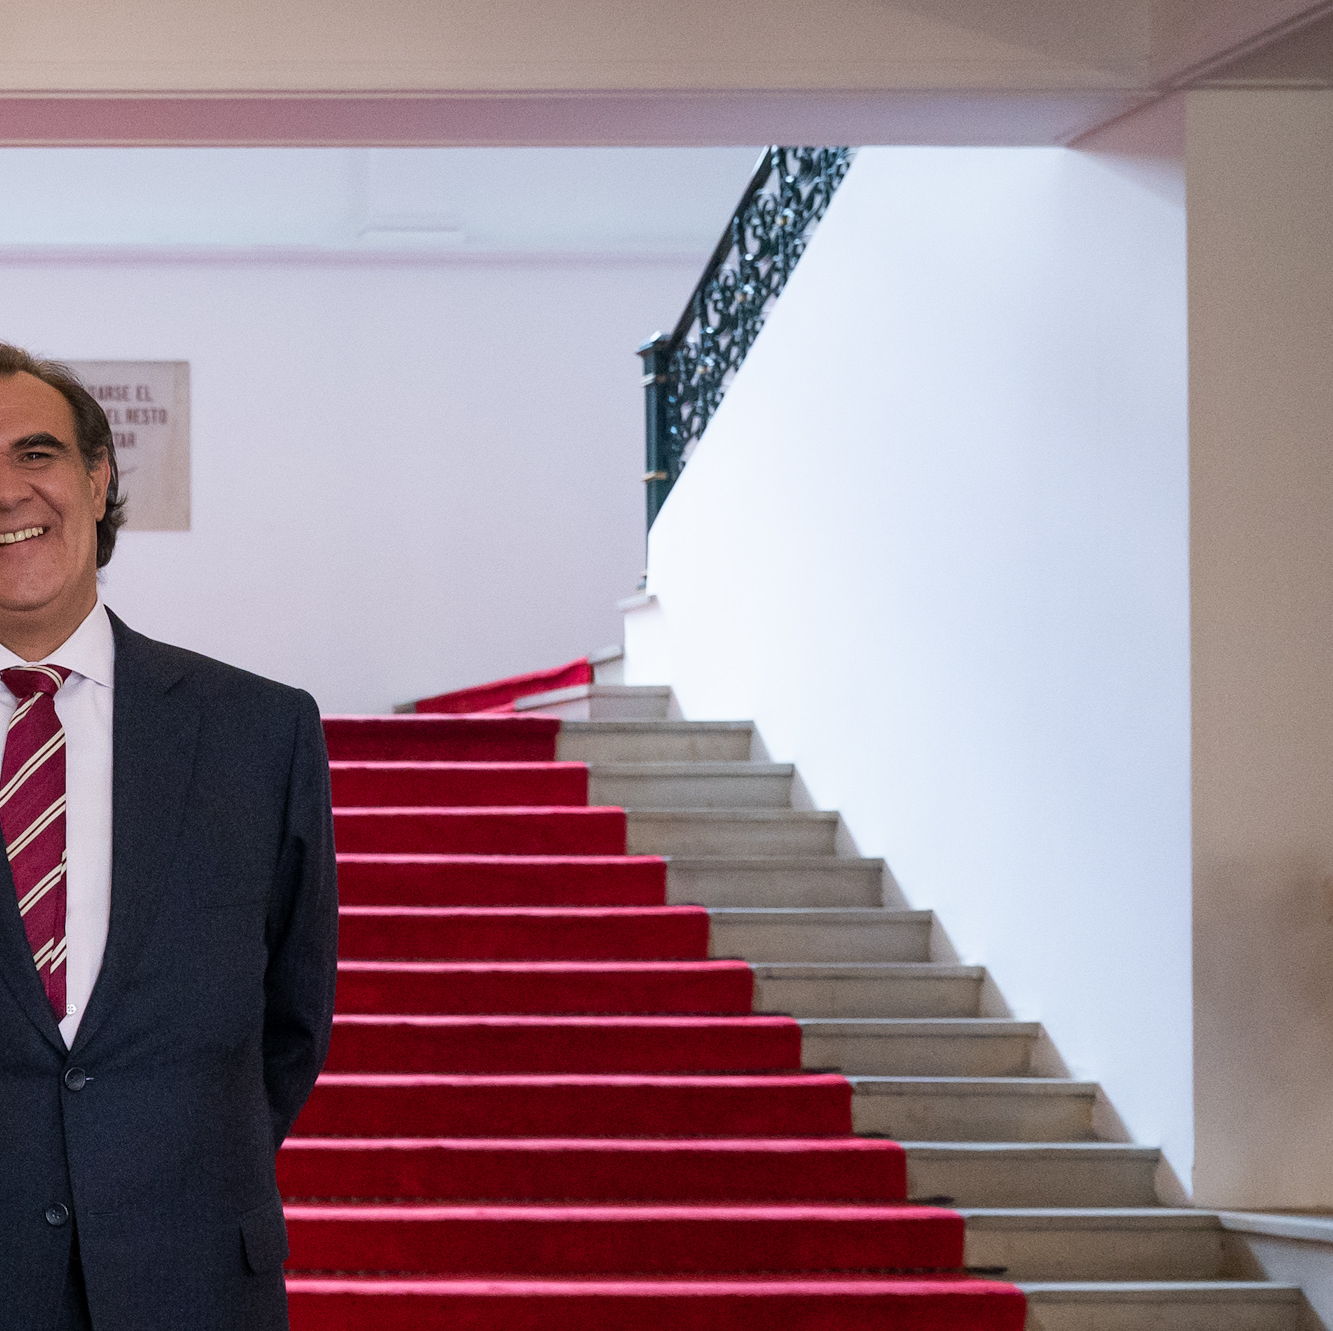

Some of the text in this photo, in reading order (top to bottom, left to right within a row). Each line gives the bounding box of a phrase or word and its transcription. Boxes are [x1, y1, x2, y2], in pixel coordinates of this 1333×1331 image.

[87, 385, 152, 402] TARSE EL
[113, 432, 135, 449] TAR
